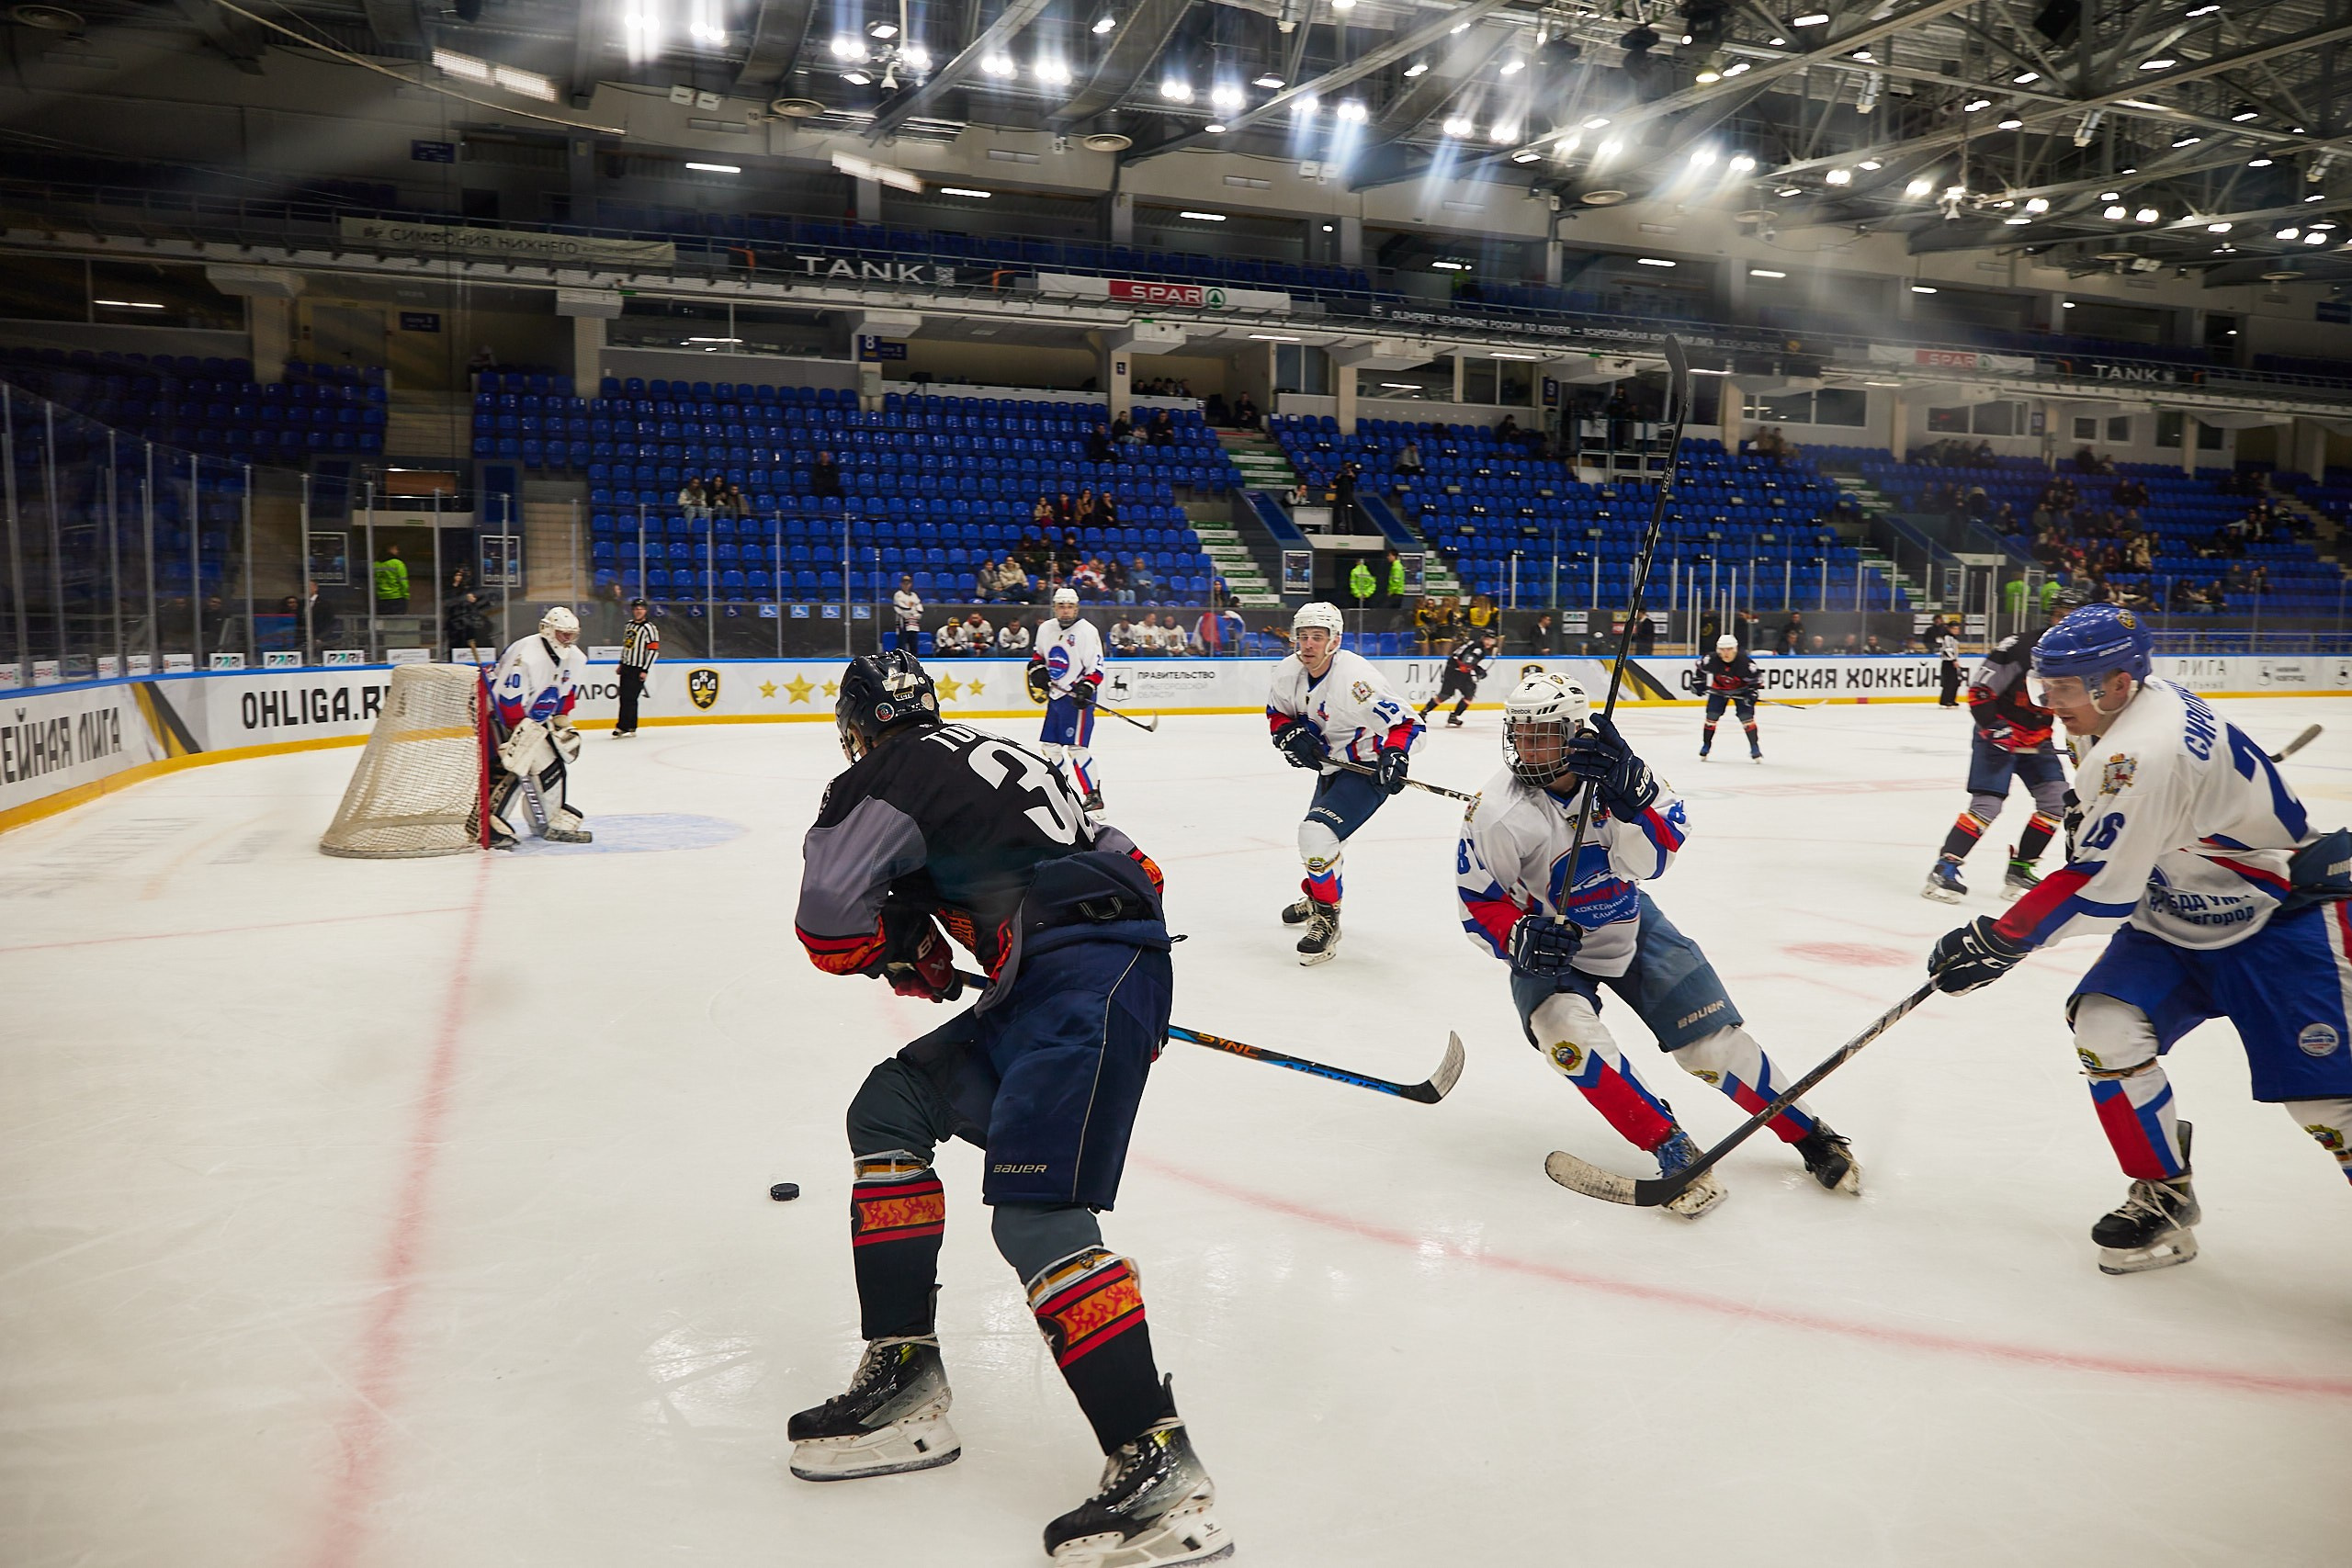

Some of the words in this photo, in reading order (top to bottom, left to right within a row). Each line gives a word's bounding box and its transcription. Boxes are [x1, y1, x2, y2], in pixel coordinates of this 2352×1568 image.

[390, 228, 490, 248] СИМФОНИЯ
[498, 239, 579, 255] НИЖНЕГО
[796, 255, 925, 285] TANK
[1130, 285, 1201, 303] SPAR
[1437, 314, 1488, 327] ЧЕМПИОНАТ
[865, 334, 875, 349] 8
[1929, 354, 1974, 367] SPAR
[2091, 364, 2158, 382] TANK
[1547, 382, 1555, 396] 9
[1137, 671, 1216, 680] ПРАВИТЕЛЬСТВО
[1846, 660, 1971, 689] ХОККЕЙНЯ
[2177, 660, 2227, 676] ЛИГА
[503, 673, 521, 689] 40
[242, 685, 393, 728] OHLIGA.R
[1372, 699, 1400, 724] 15
[0, 707, 74, 786] ЕЙНАЯ
[79, 706, 122, 763] ЛИГА
[1677, 999, 1725, 1029] BAUER
[1196, 1032, 1261, 1057] SYNC
[993, 1164, 1047, 1173] BAUER
